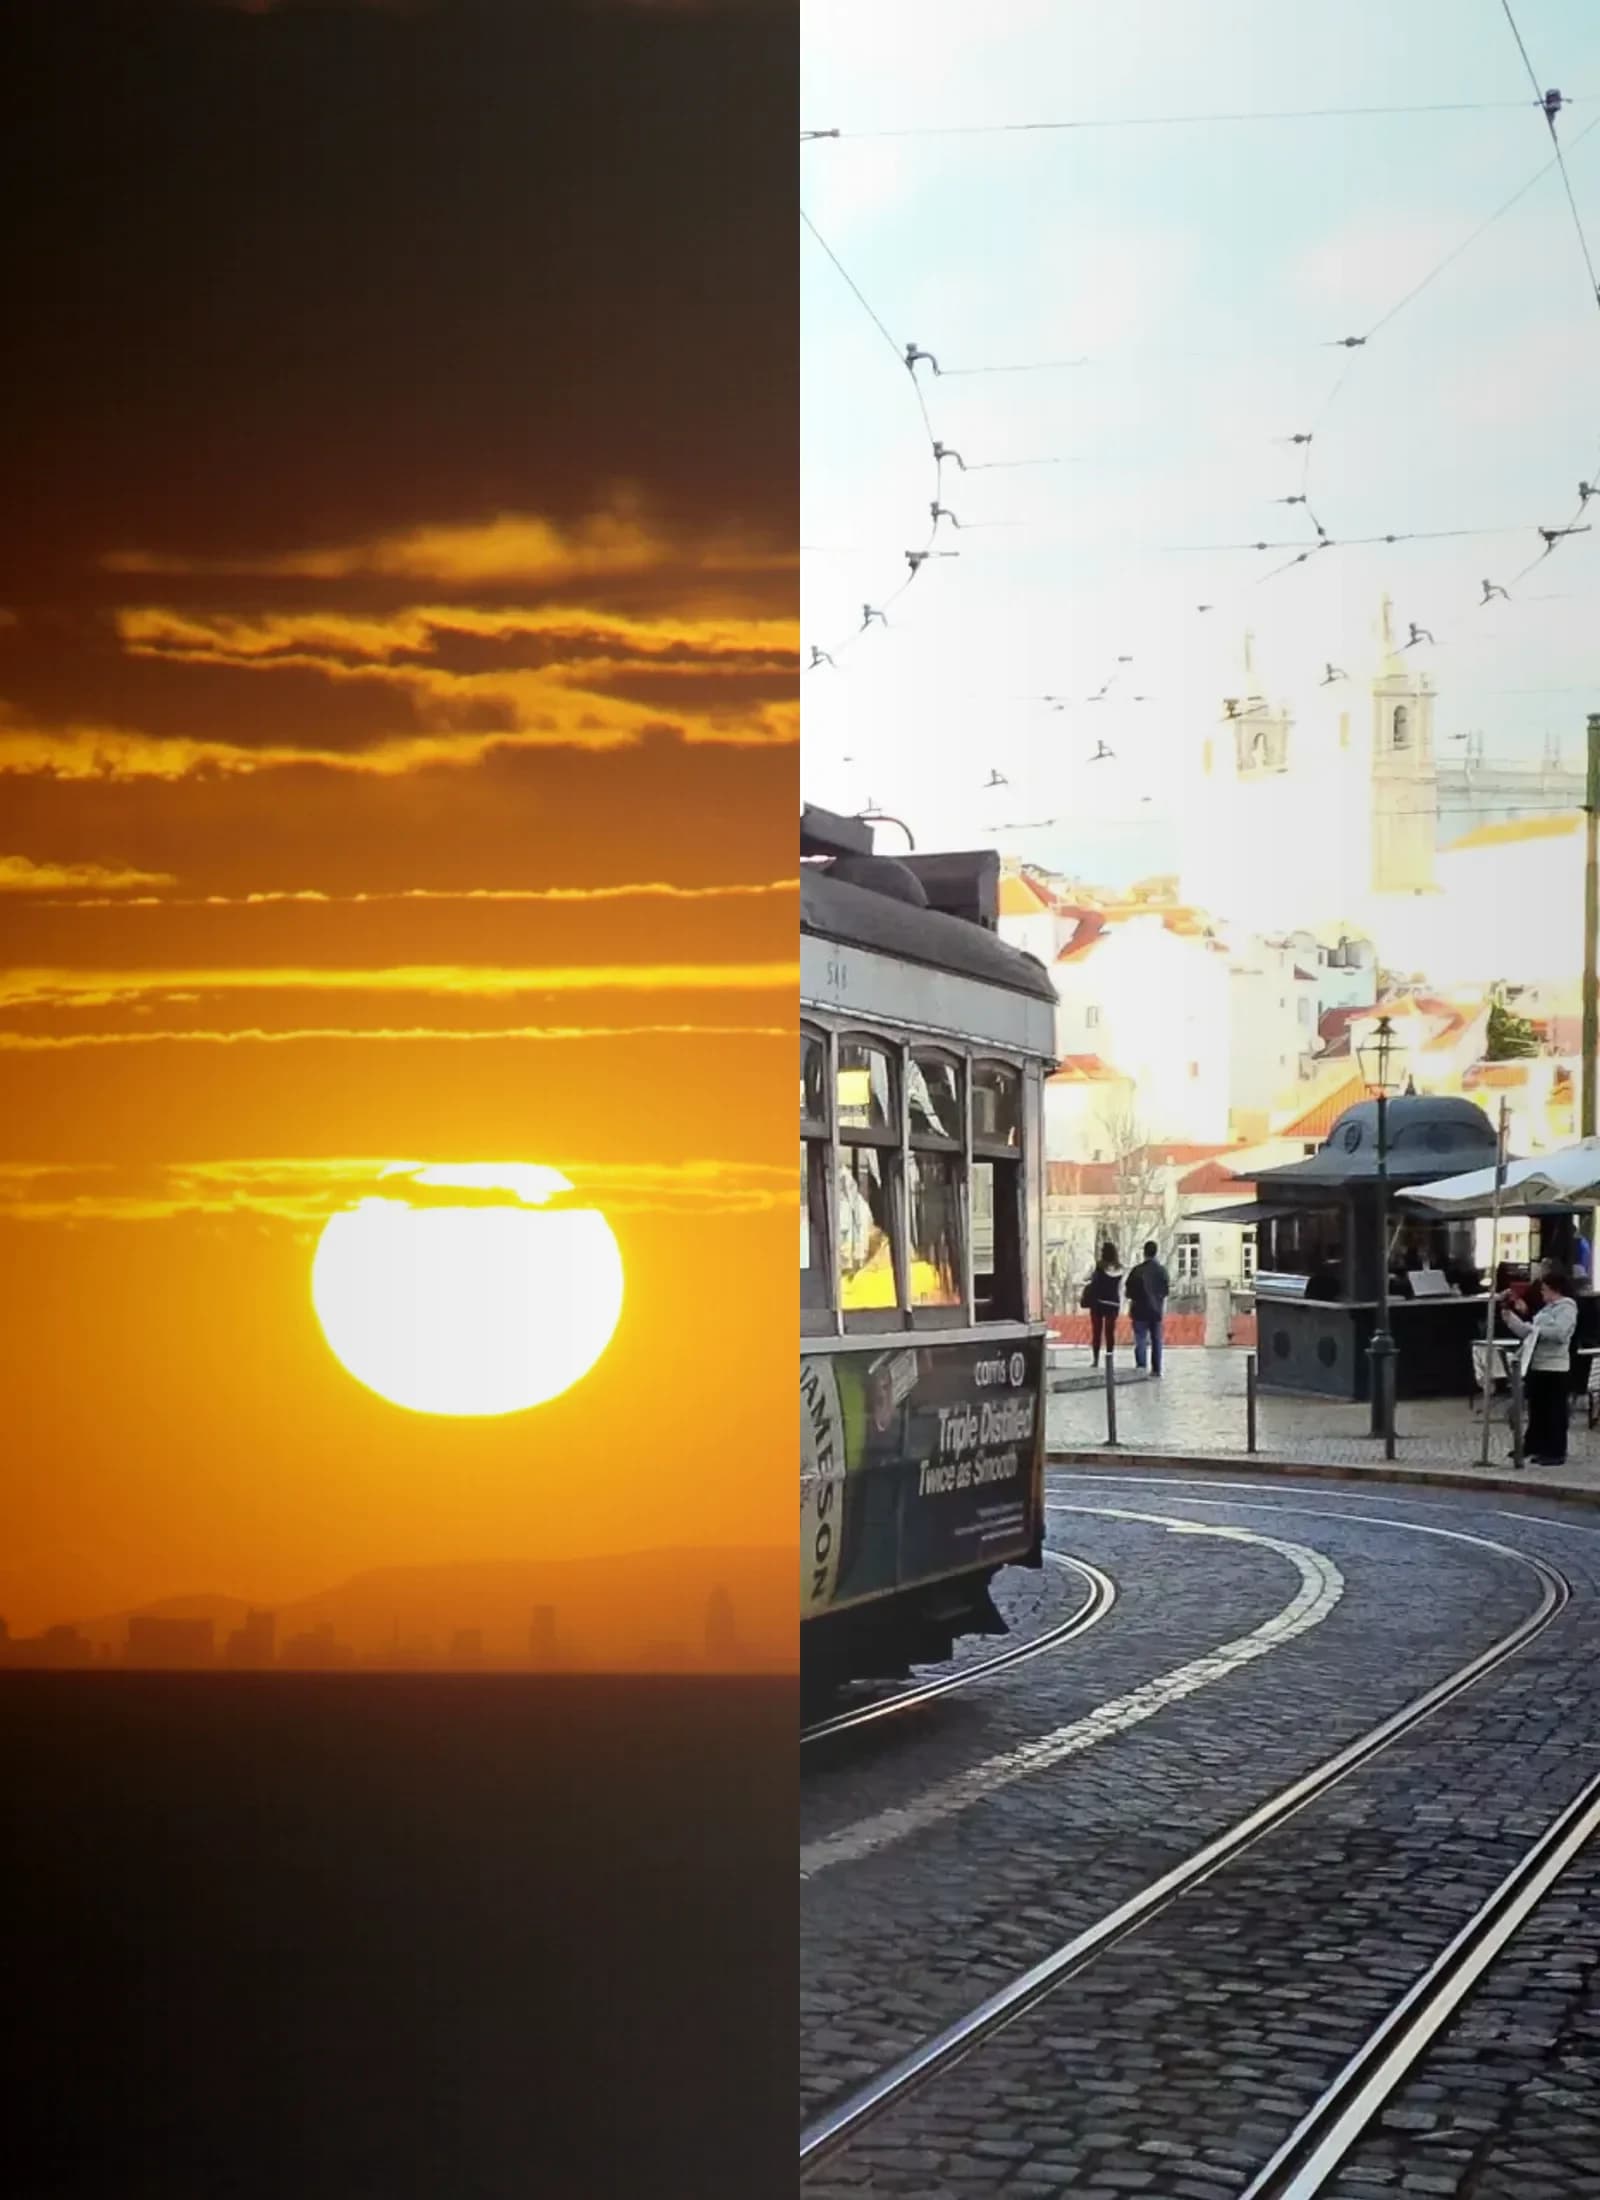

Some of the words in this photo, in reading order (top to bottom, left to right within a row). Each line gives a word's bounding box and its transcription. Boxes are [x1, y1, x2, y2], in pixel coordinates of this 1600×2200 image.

[938, 1403, 978, 1460] Triple
[979, 1396, 1033, 1444] Distilled
[919, 1457, 956, 1496] Twice
[956, 1461, 973, 1488] as
[973, 1445, 1018, 1486] Smooth
